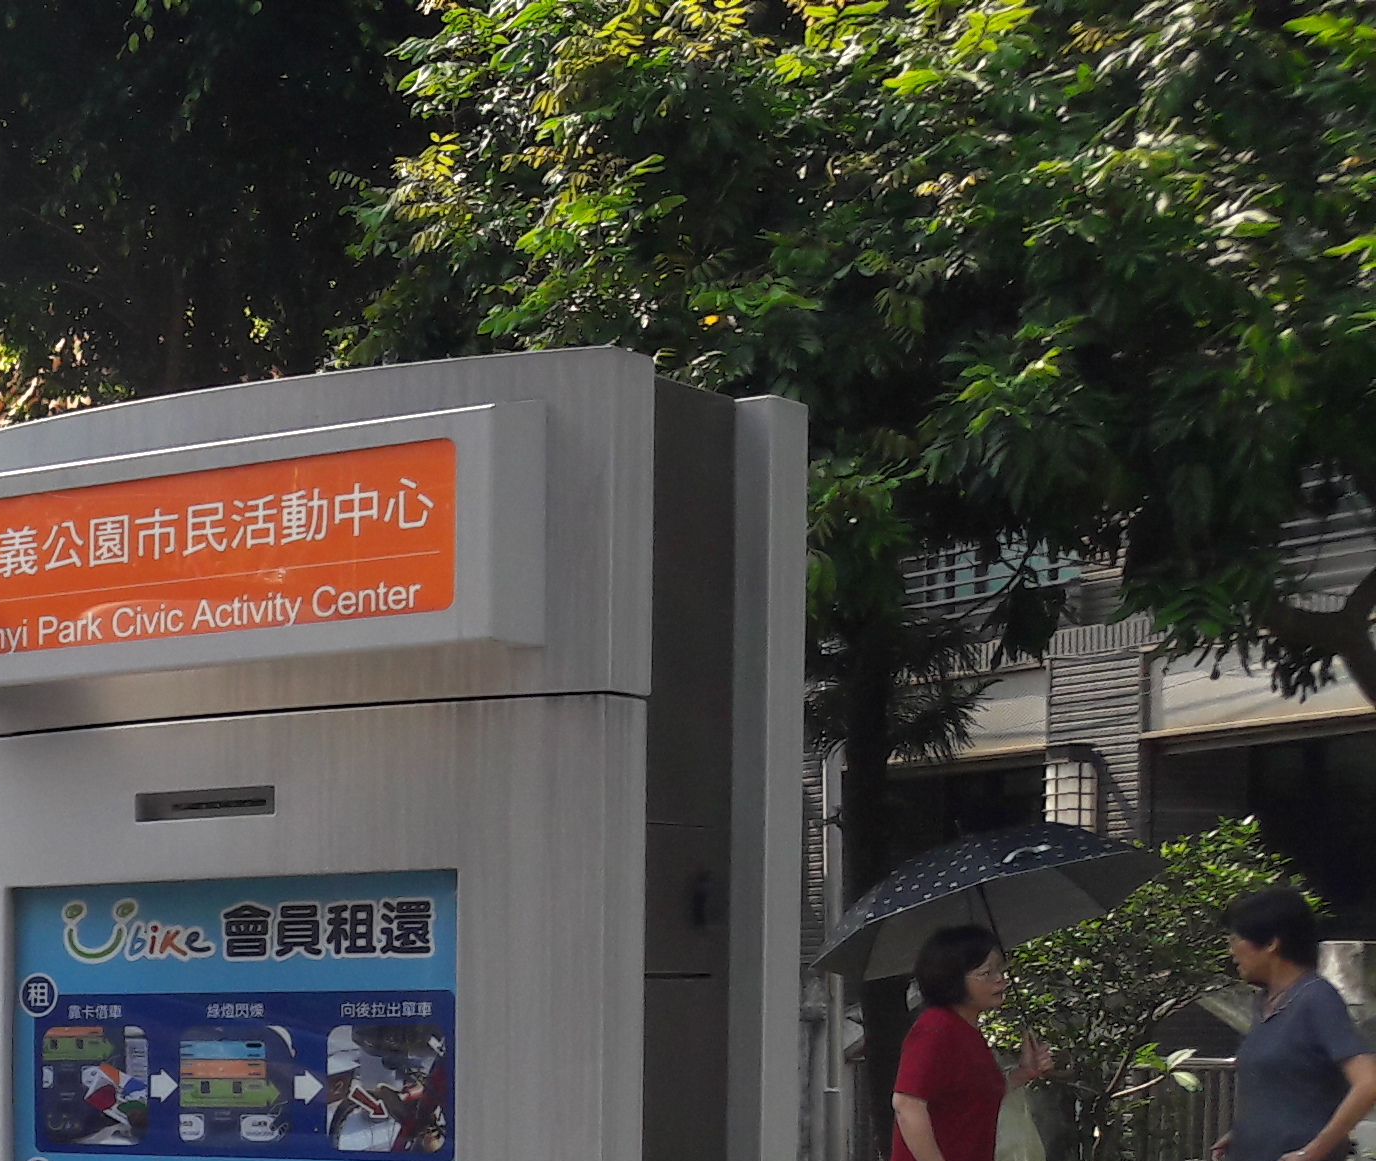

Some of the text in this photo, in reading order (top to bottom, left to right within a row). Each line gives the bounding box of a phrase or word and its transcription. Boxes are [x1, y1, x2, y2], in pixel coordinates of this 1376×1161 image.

[37, 614, 103, 646] Park
[112, 603, 184, 638] Civic
[191, 591, 302, 629] Activity
[312, 580, 421, 618] Center
[221, 897, 435, 961] 會員租還
[27, 984, 49, 1007] 租
